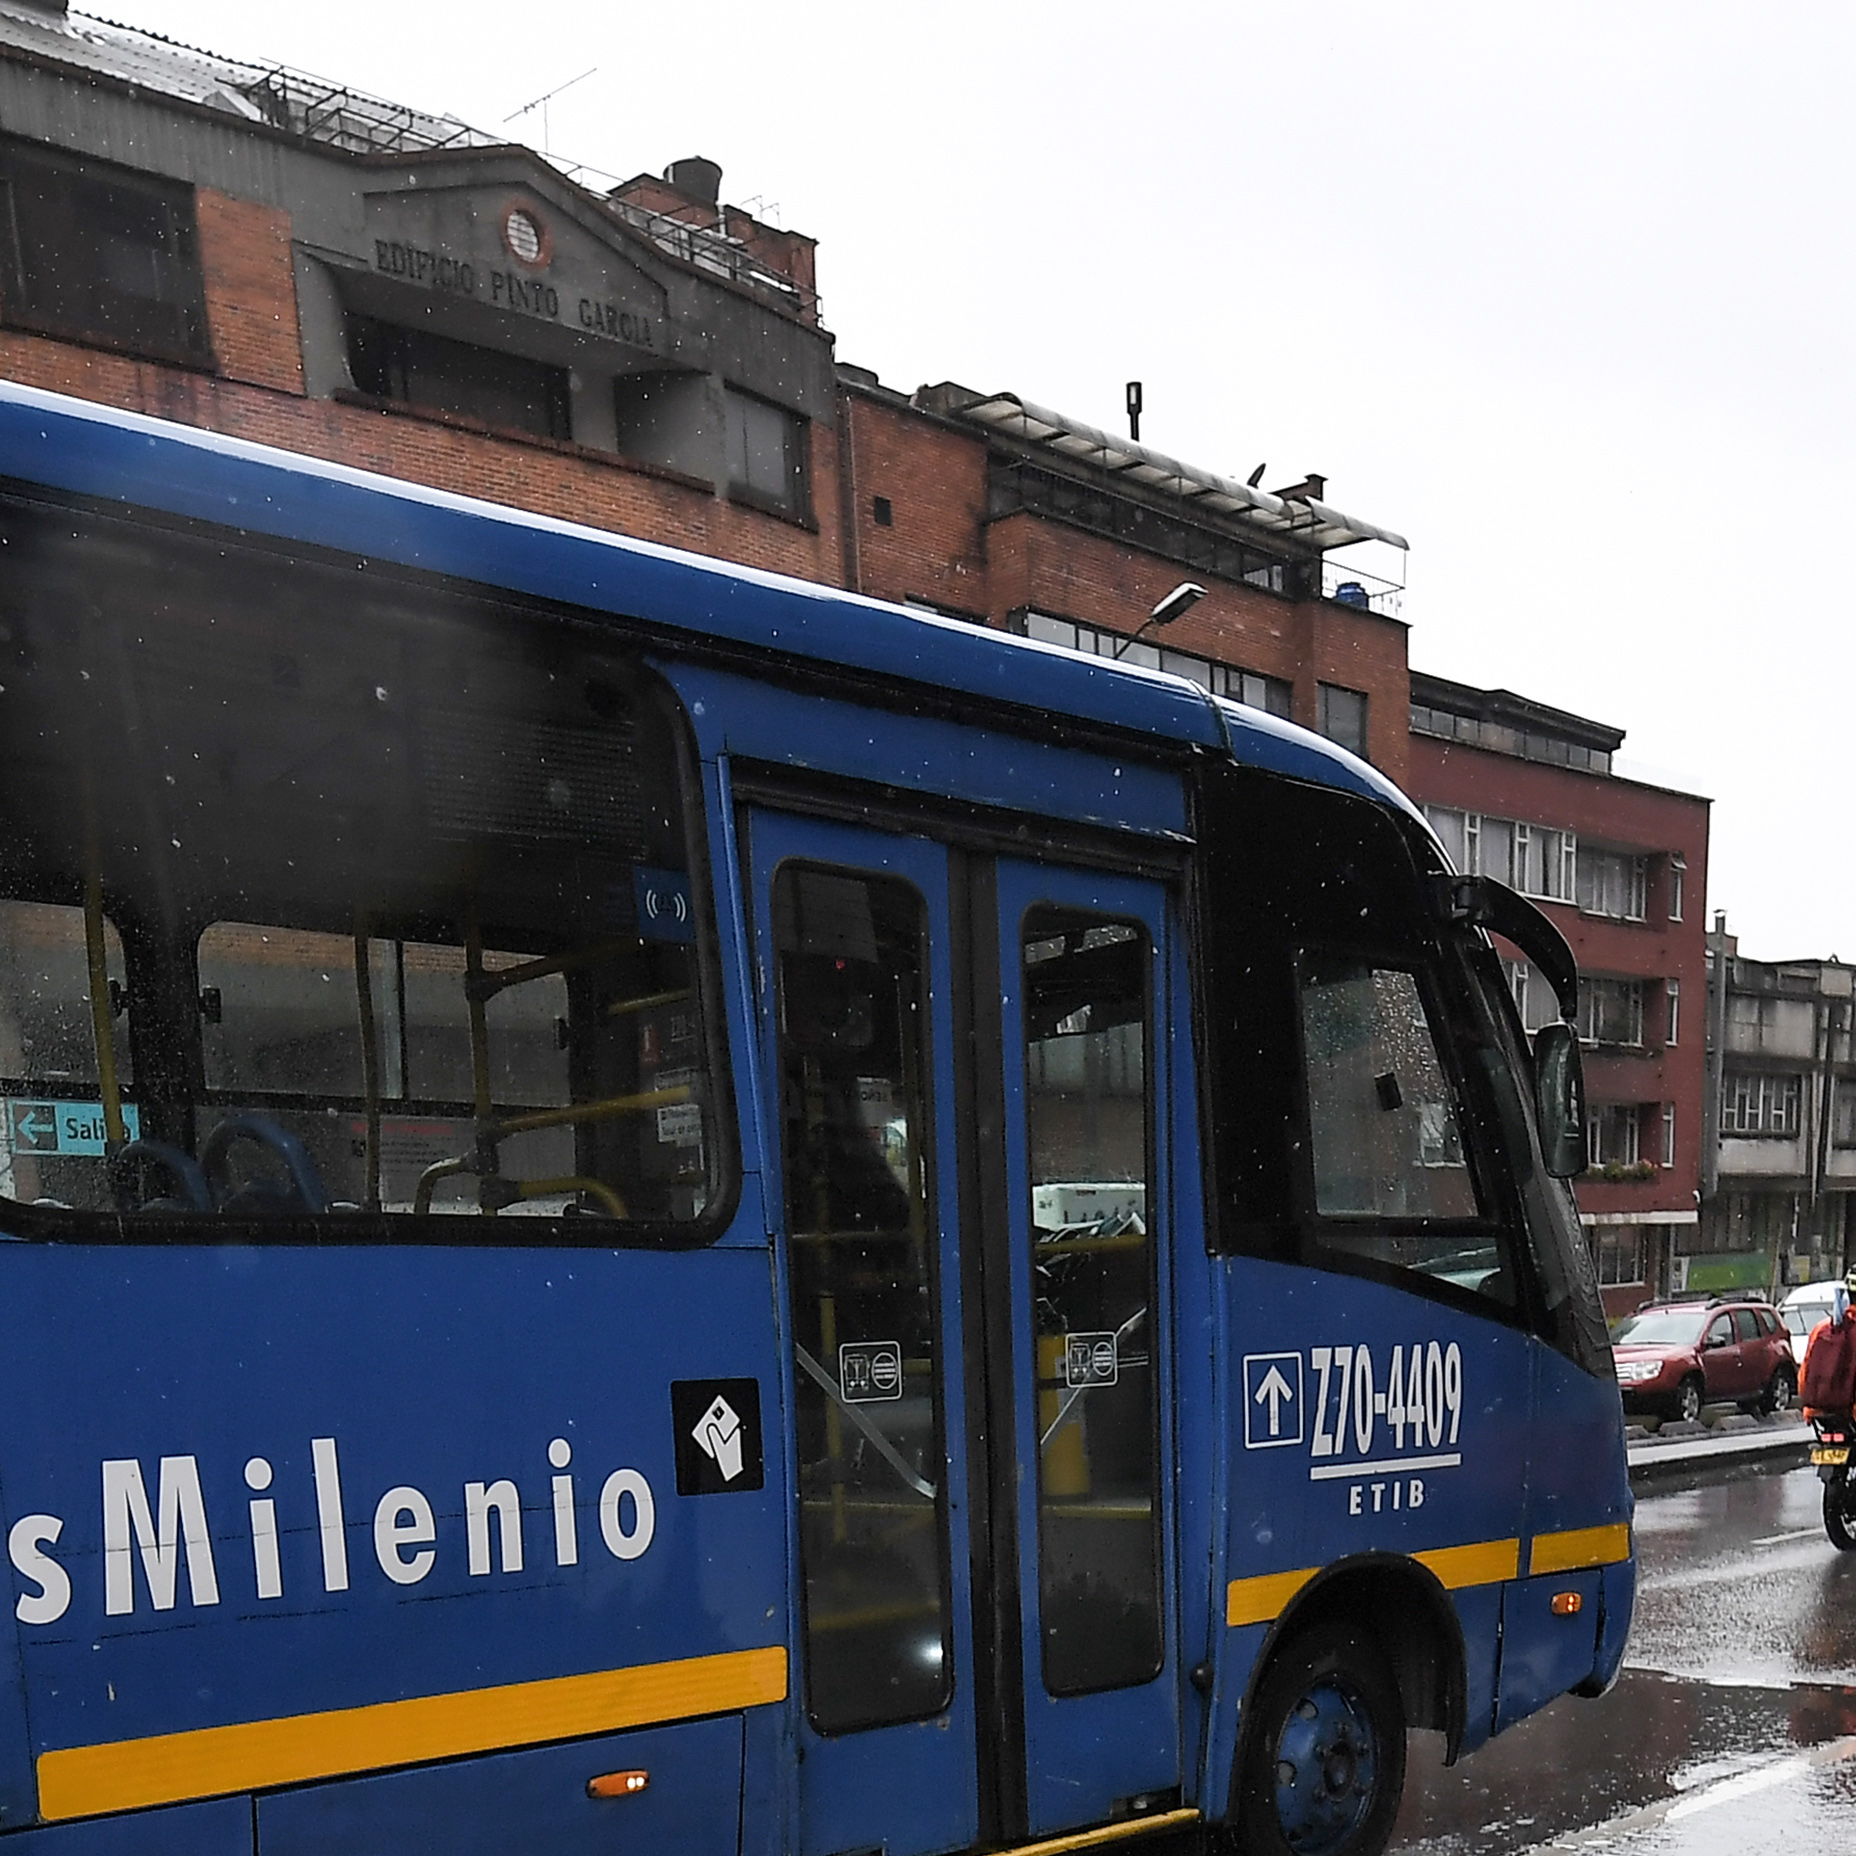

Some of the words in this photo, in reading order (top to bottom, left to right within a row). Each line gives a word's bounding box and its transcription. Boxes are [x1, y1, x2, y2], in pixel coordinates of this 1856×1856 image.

[373, 239, 475, 295] EDIFICIO
[490, 270, 559, 318] PINTO
[1310, 1340, 1462, 1457] Z70-4409
[1349, 1478, 1425, 1516] ETIB
